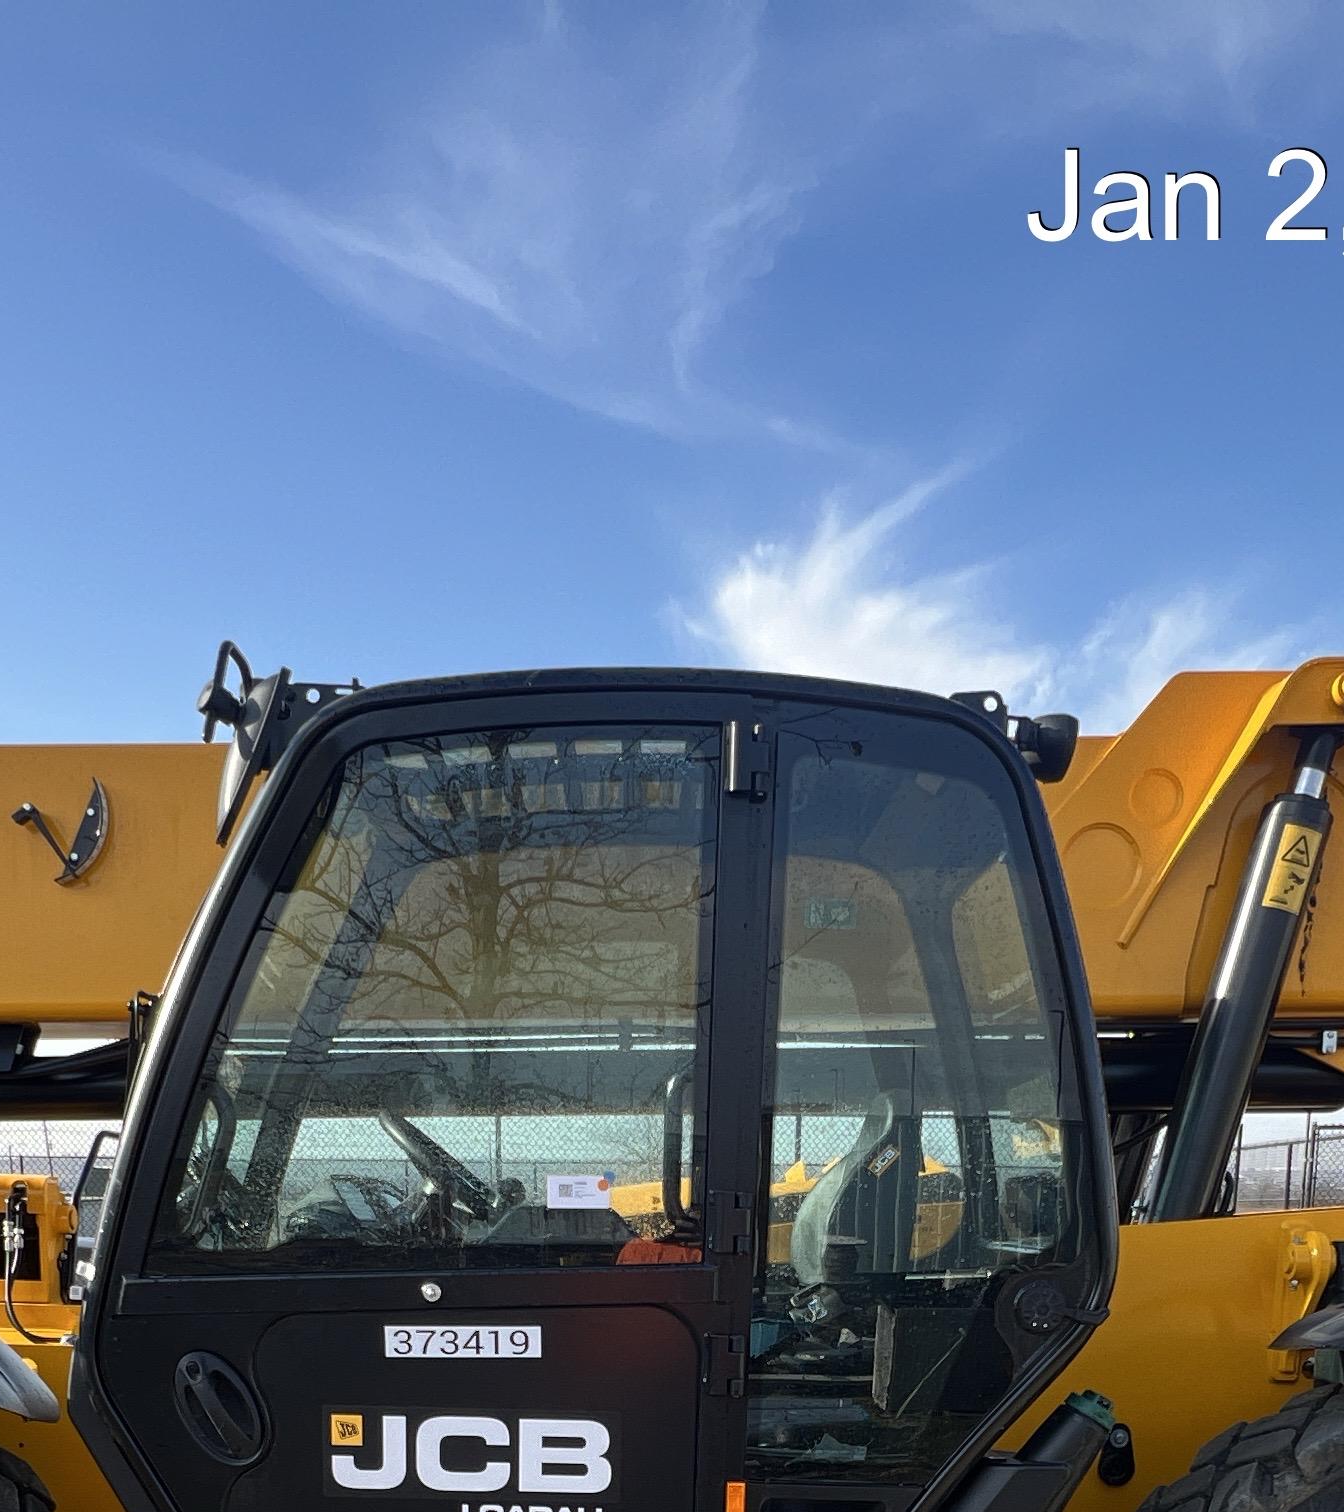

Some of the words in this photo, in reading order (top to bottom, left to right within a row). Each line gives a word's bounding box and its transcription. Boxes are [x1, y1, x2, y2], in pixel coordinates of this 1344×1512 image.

[871, 1149, 896, 1173] JCB
[392, 1329, 530, 1355] 373419
[331, 1414, 613, 1494] JCB
